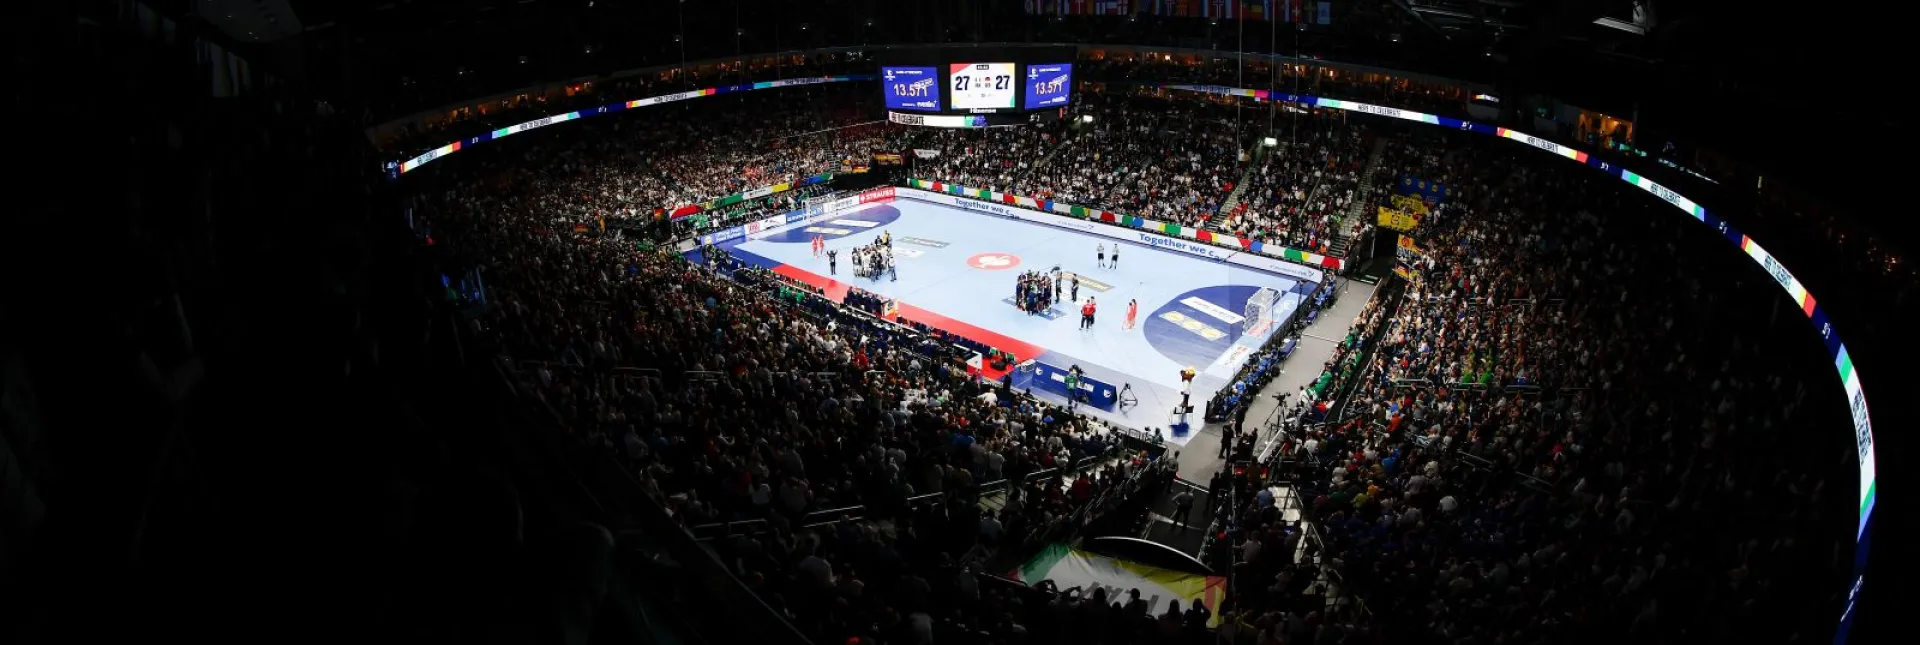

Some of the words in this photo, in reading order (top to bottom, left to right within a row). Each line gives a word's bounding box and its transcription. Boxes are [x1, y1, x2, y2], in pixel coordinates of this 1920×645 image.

[955, 76, 970, 91] 27
[996, 75, 1011, 90] 27
[955, 197, 989, 209] Together
[1139, 233, 1186, 249] Together
[1189, 245, 1206, 254] we
